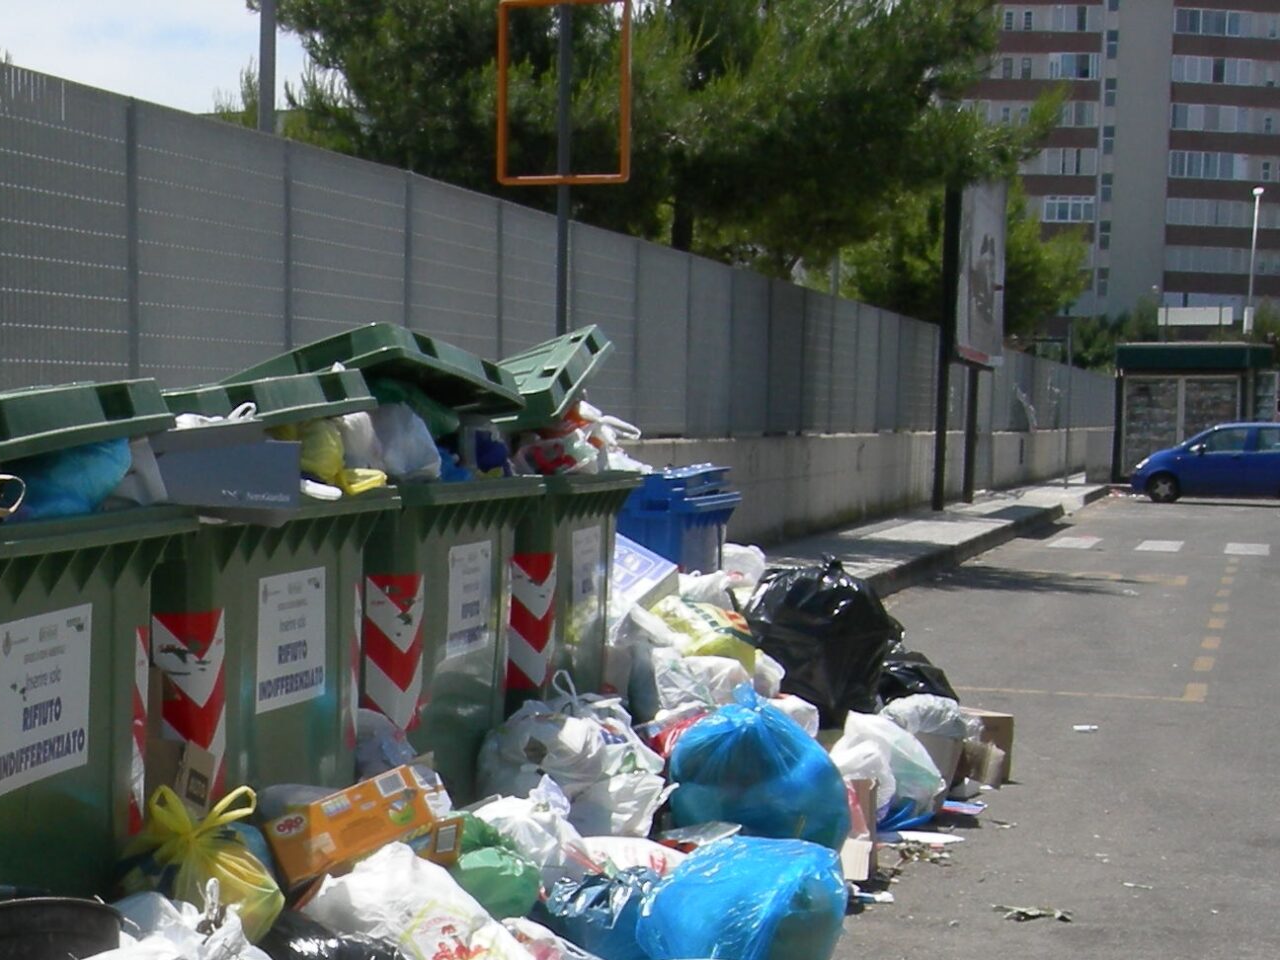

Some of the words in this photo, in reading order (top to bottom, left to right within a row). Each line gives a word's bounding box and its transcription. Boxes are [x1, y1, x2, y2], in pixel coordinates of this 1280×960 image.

[277, 639, 308, 664] RIFIUTO
[22, 696, 63, 732] RIFIUTO
[0, 727, 85, 781] INDIFFERENZIATO
